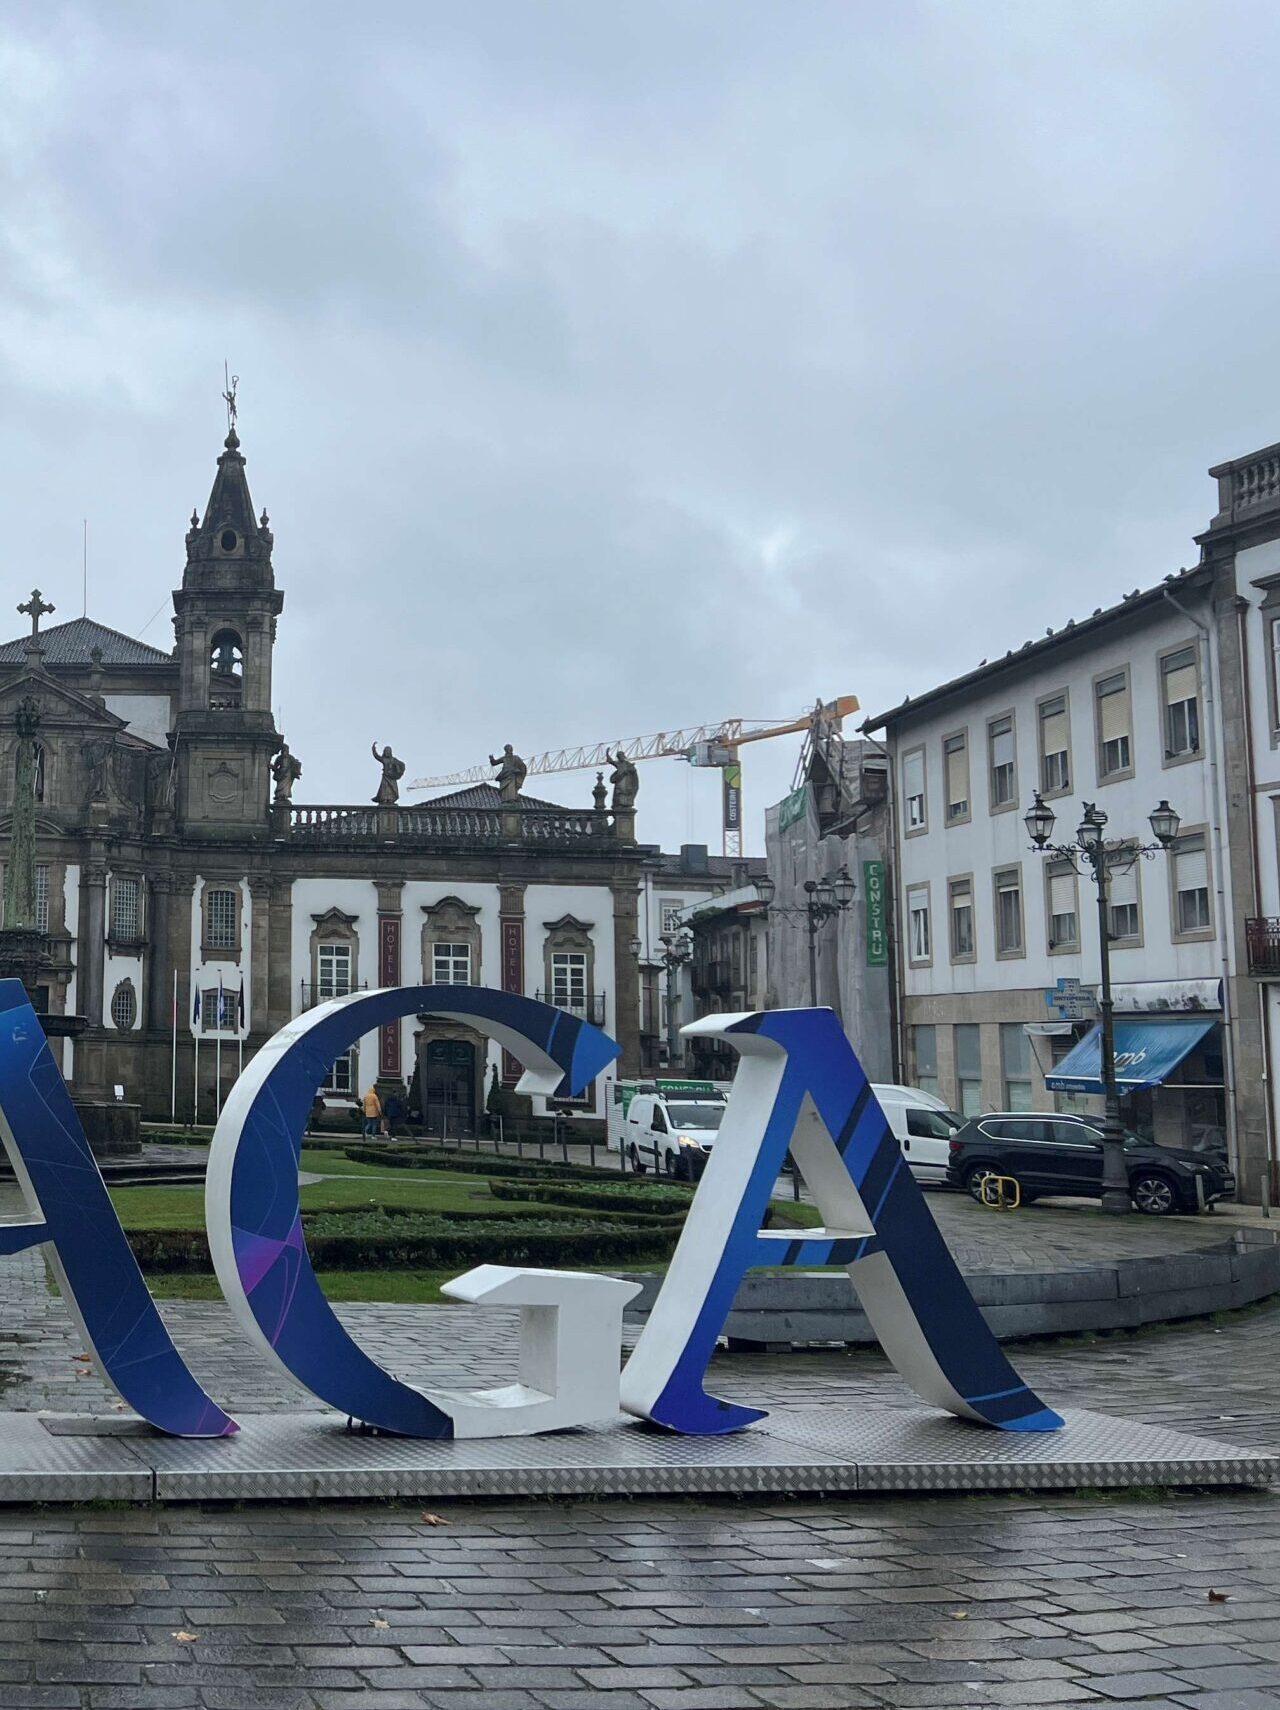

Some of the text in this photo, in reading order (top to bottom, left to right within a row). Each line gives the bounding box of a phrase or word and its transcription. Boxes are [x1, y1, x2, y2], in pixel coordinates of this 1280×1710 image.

[869, 864, 882, 955] CONSTRU
[387, 925, 395, 973] HOTEL
[508, 928, 517, 976] HOTEL
